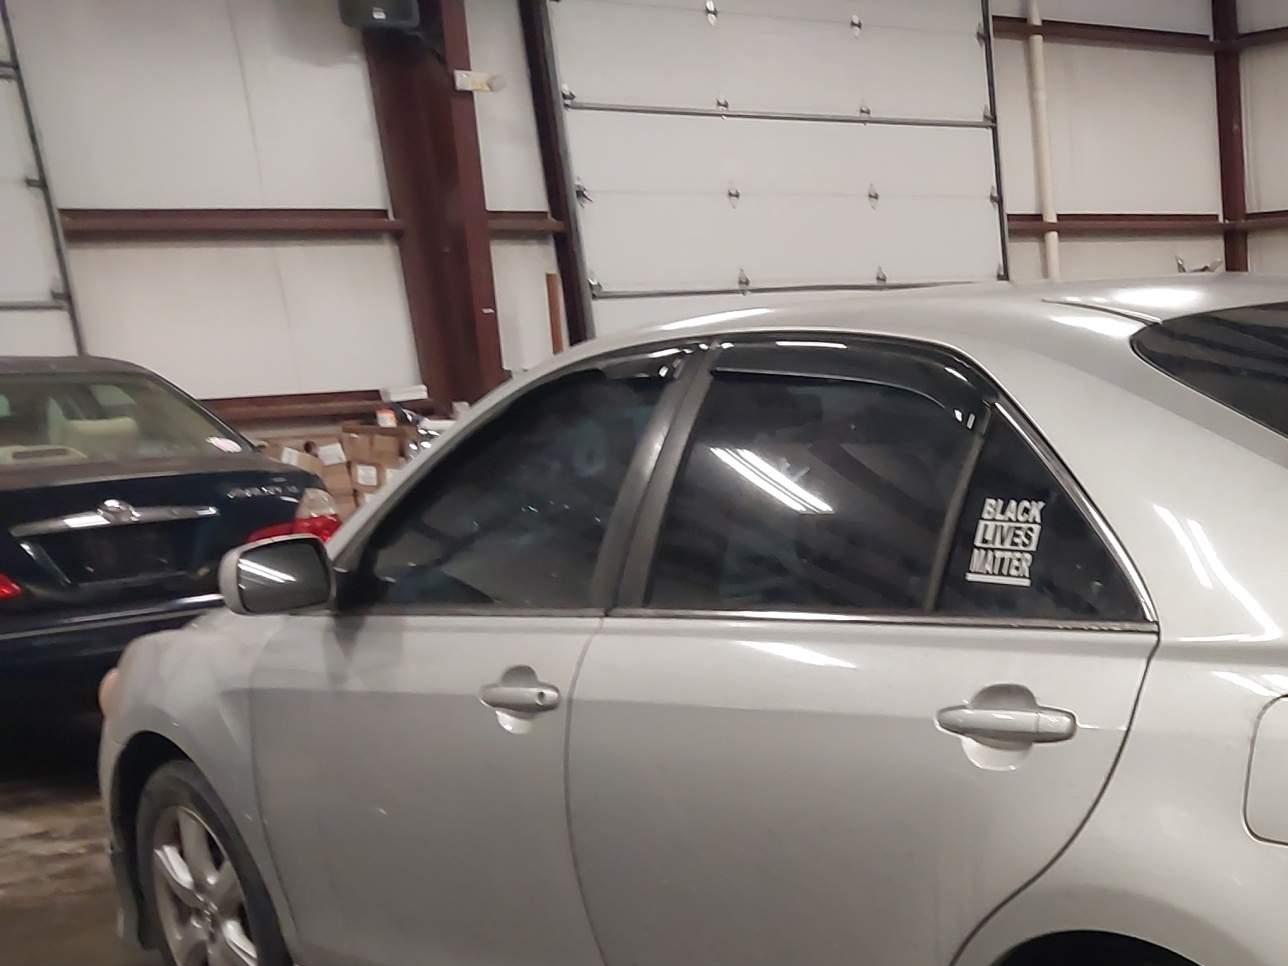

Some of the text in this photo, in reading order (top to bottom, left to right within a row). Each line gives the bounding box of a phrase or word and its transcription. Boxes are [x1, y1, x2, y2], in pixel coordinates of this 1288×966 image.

[981, 498, 1046, 523] BLACK
[980, 523, 1036, 549] LIVES
[969, 547, 1033, 578] MATTER
